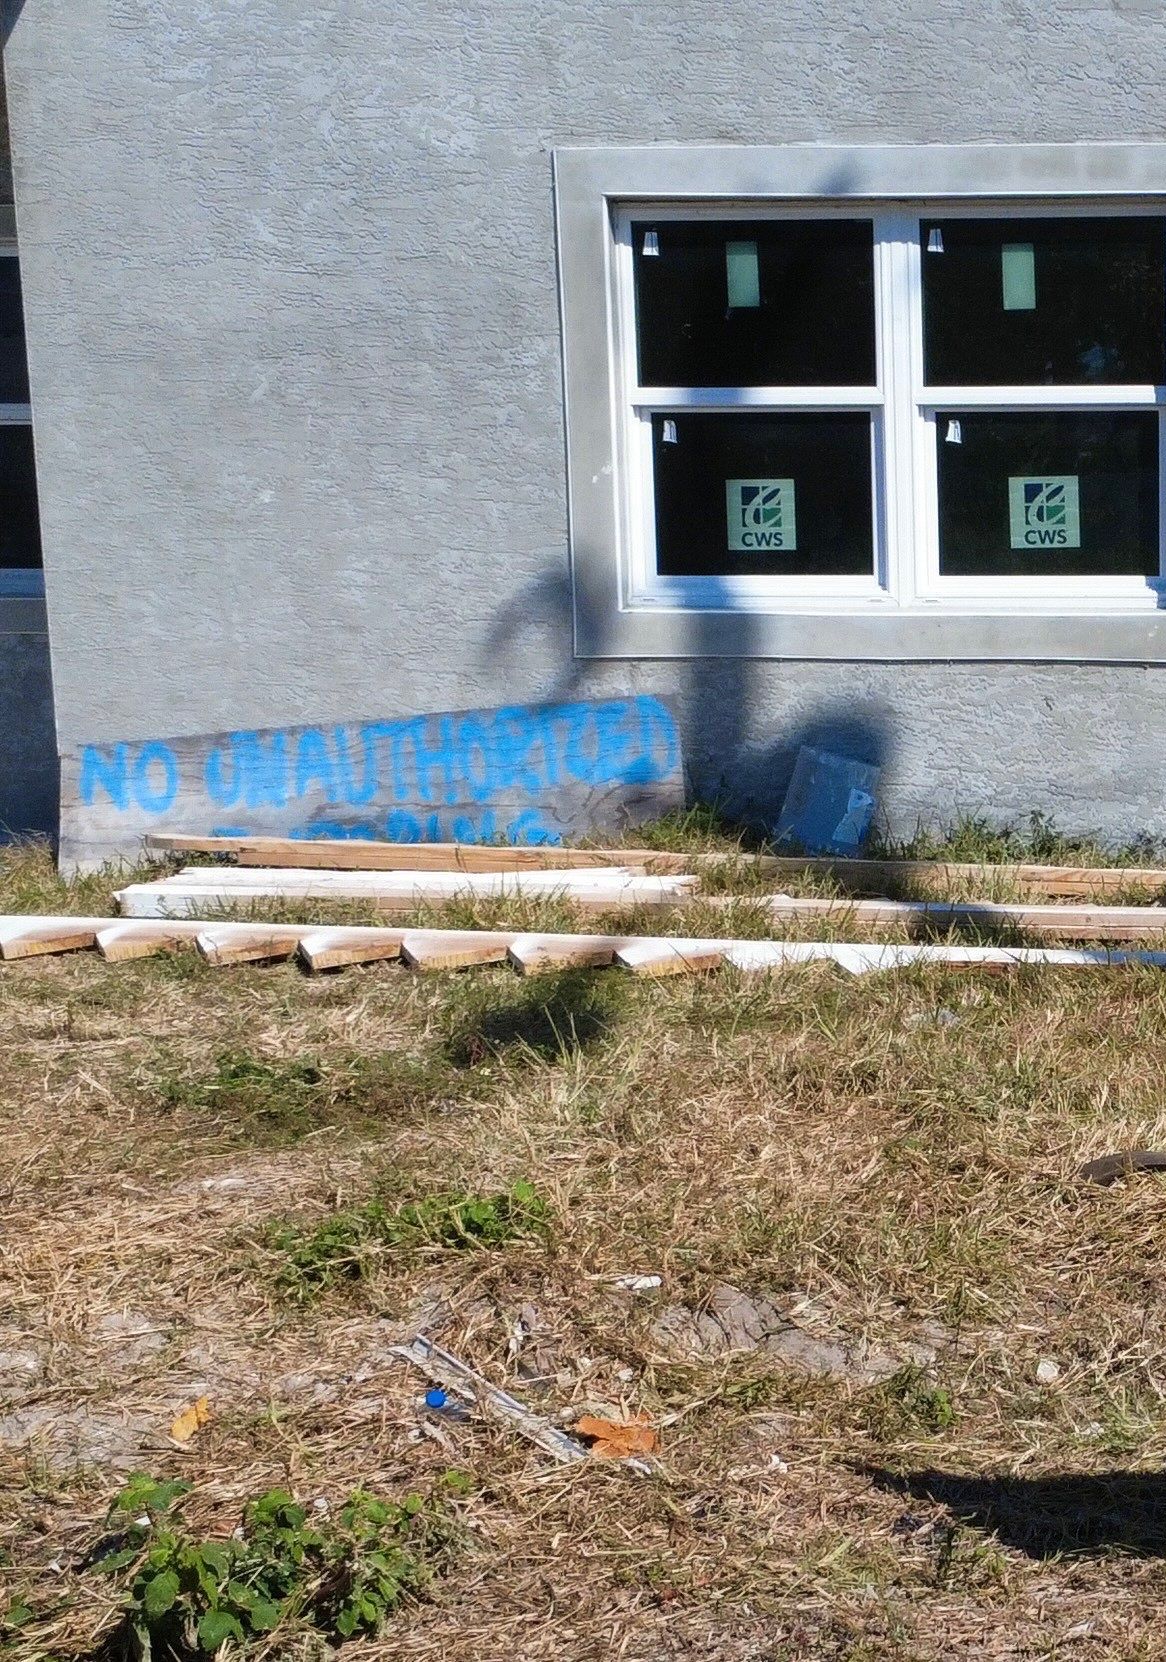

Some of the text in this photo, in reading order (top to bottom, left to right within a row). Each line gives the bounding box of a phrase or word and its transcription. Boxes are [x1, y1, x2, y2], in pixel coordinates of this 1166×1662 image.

[741, 532, 783, 547] CWS
[1024, 529, 1067, 545] CWS
[79, 741, 178, 814] NO
